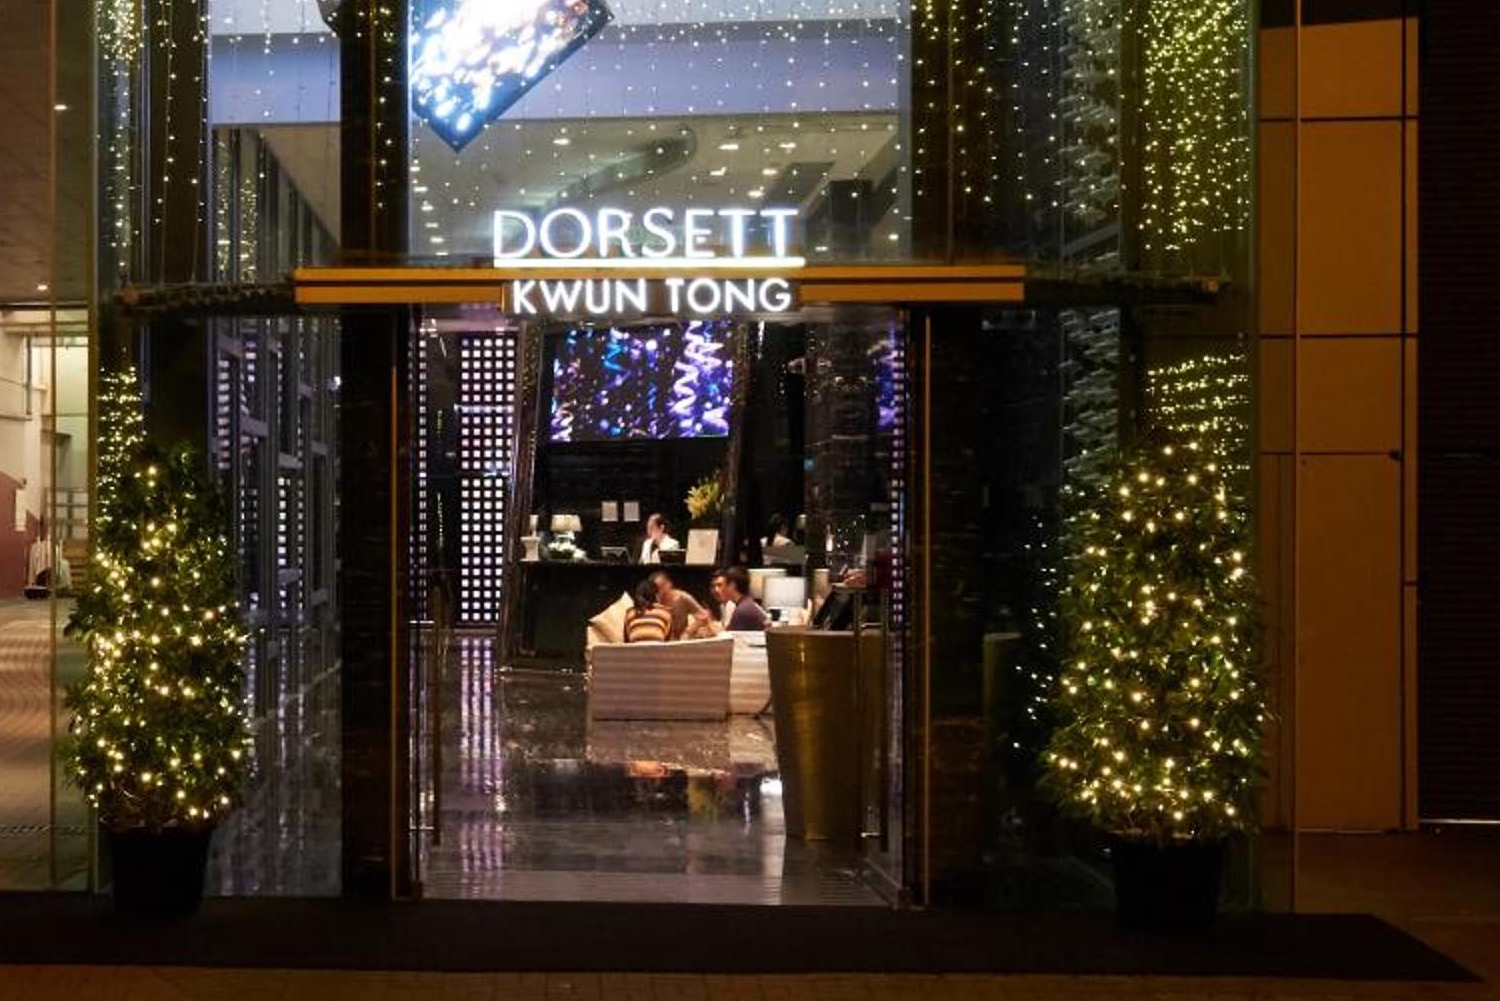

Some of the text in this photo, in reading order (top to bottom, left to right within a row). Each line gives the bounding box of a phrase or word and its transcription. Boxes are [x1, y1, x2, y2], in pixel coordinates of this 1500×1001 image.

[493, 208, 798, 258] DORSETT
[513, 278, 791, 313] KWUN TONG
